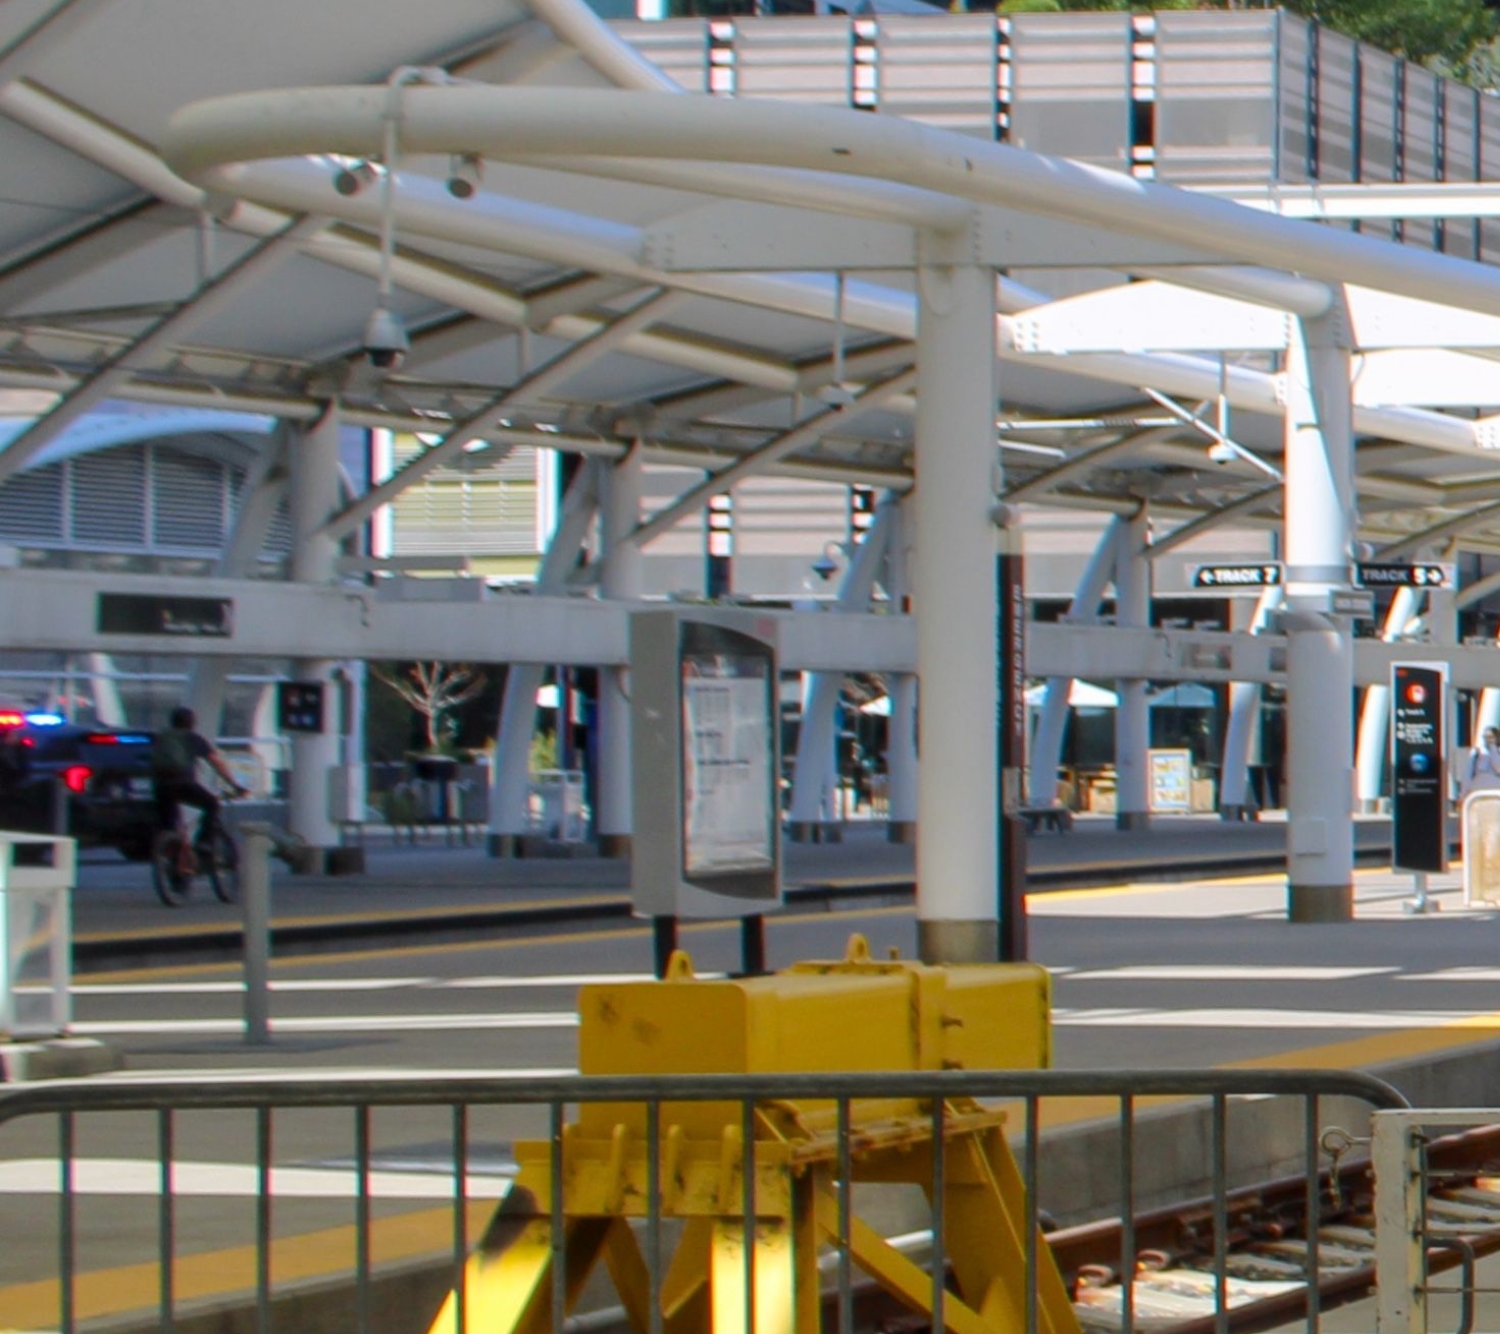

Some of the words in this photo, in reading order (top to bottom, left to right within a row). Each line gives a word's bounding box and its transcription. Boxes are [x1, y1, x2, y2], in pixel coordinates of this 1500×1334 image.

[1213, 568, 1261, 584] TRACK
[1264, 566, 1278, 584] 7
[1362, 568, 1409, 582] TRACK
[1413, 566, 1427, 585] 5
